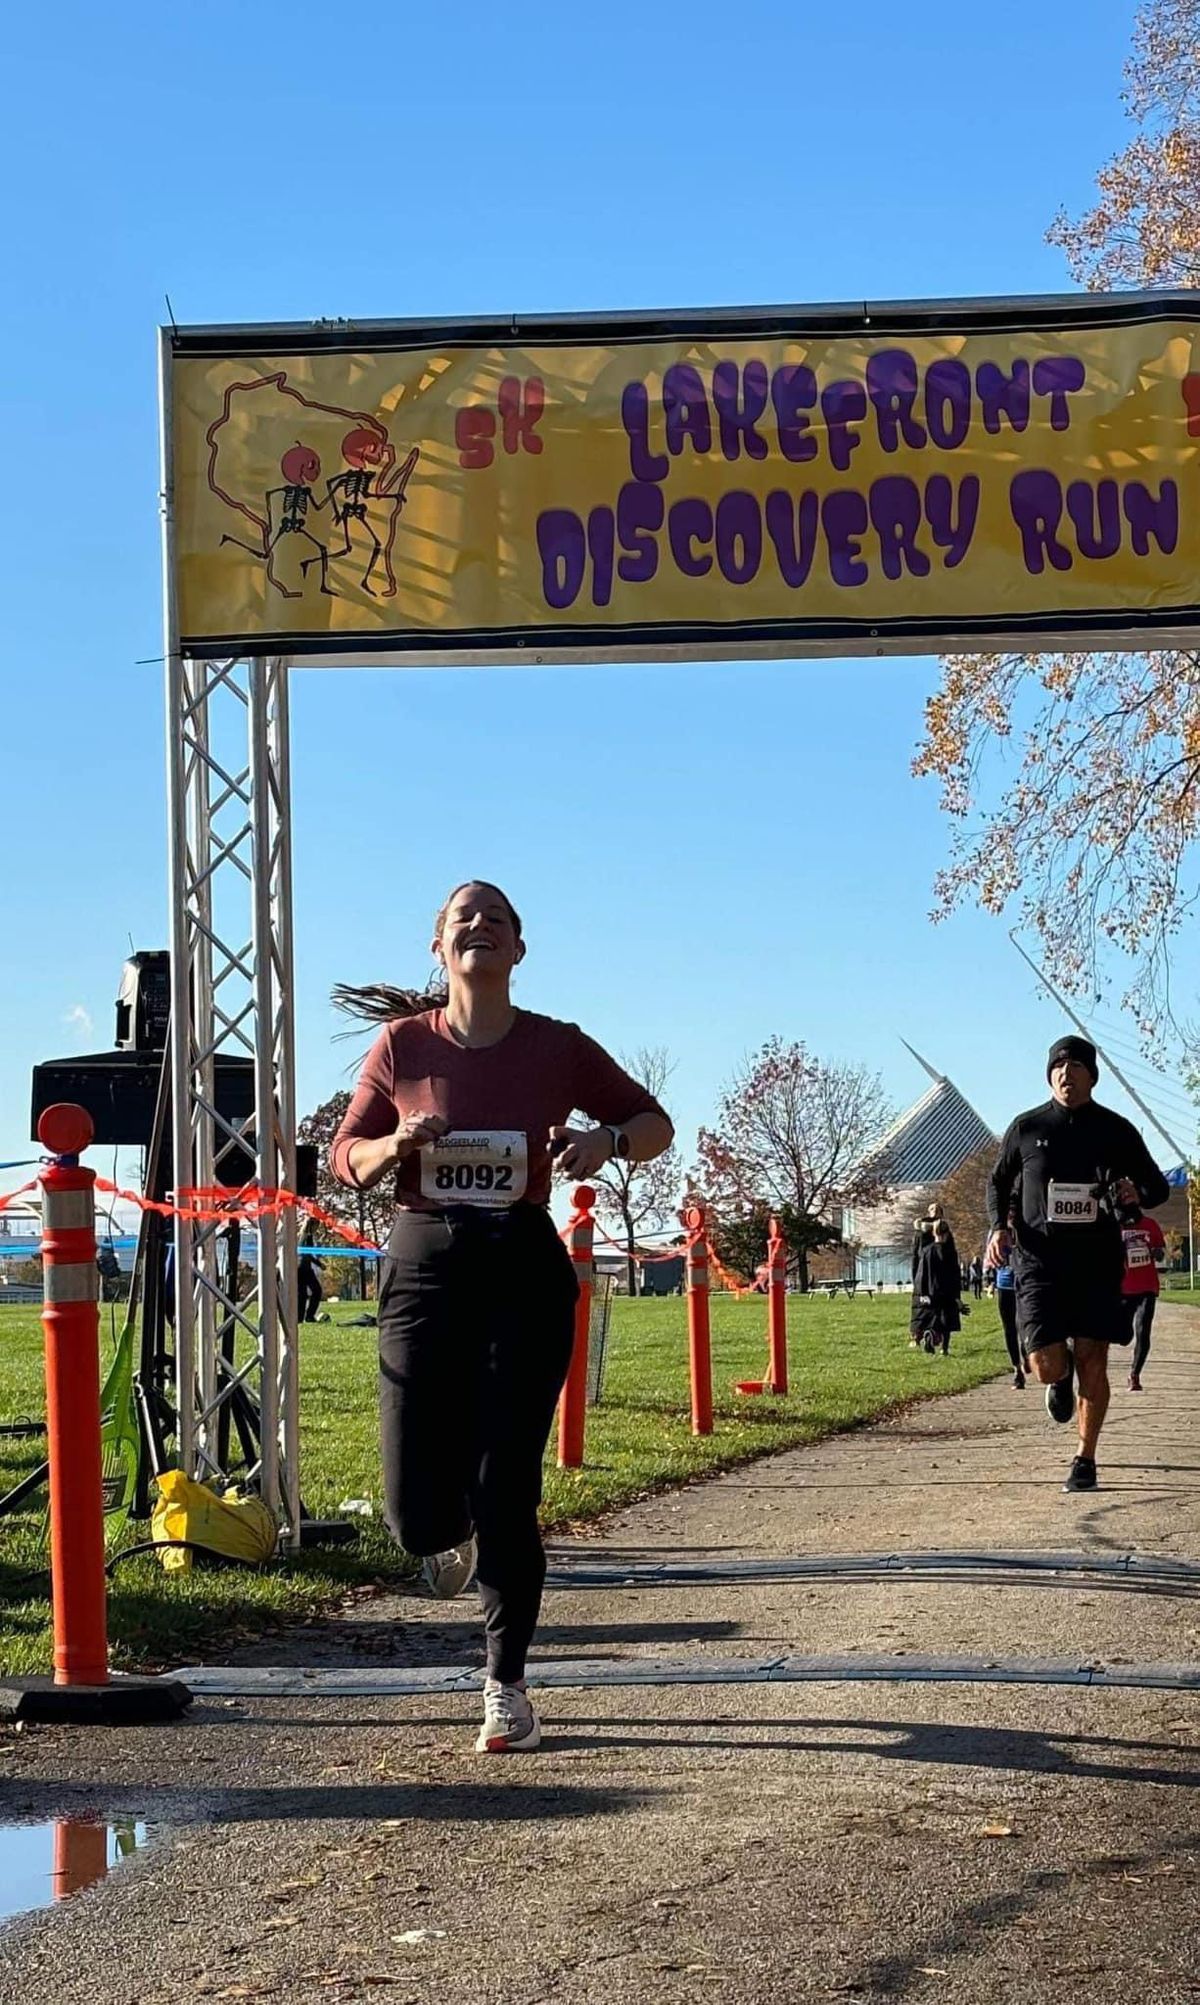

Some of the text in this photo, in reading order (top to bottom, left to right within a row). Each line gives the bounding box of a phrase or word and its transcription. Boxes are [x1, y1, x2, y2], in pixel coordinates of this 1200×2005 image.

[621, 349, 1086, 482] LAKEFRONT
[536, 469, 1178, 609] DISCOVERY RUN
[435, 1163, 513, 1191] 8092
[1054, 1200, 1092, 1215] 8084
